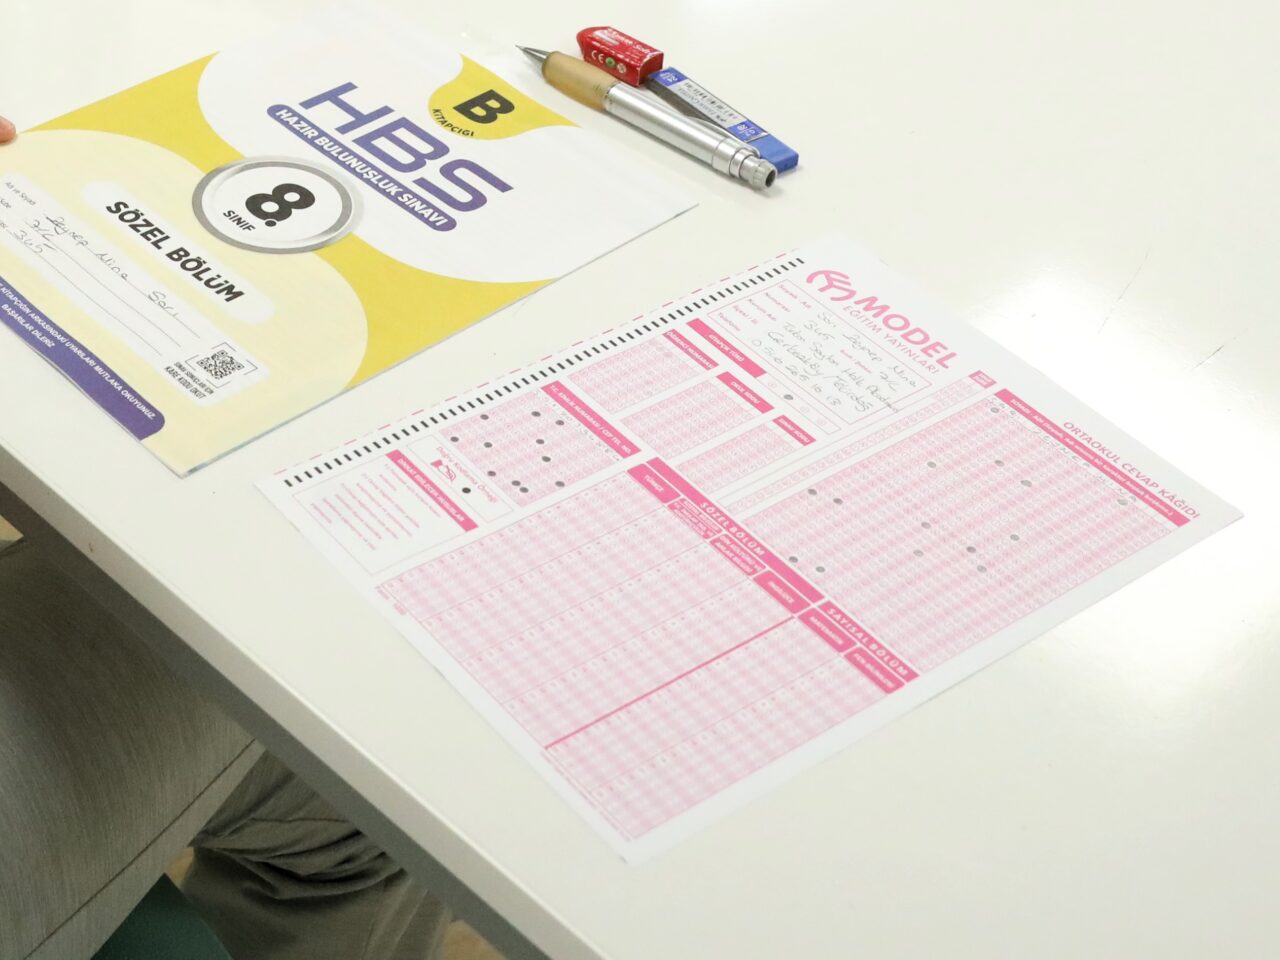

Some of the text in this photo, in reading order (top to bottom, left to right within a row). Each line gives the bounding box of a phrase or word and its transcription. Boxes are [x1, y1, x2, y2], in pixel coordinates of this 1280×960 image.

[432, 108, 475, 137] KİTAPÇIĞI
[453, 88, 515, 124] B
[275, 109, 447, 225] HAZIR BULUNUŞLUK SINAVI
[298, 81, 514, 212] HBS
[222, 209, 255, 230] SINIF
[106, 201, 243, 301] SÖZEL BÖLÜM
[1, 303, 34, 331] BAŞARILAR
[842, 305, 939, 374] EĞİTİM YAYINLARI
[854, 295, 958, 369] MODEL
[93, 365, 122, 391] MUTLAKA
[164, 366, 206, 397] KARE KODU OKUT
[1062, 421, 1120, 463] ORTAOKUL
[1121, 462, 1159, 488] CEVAP
[700, 502, 729, 527] SÖZEL
[728, 526, 764, 555] BÖLÜM
[827, 608, 907, 675] SAYISAL BÖLÜM
